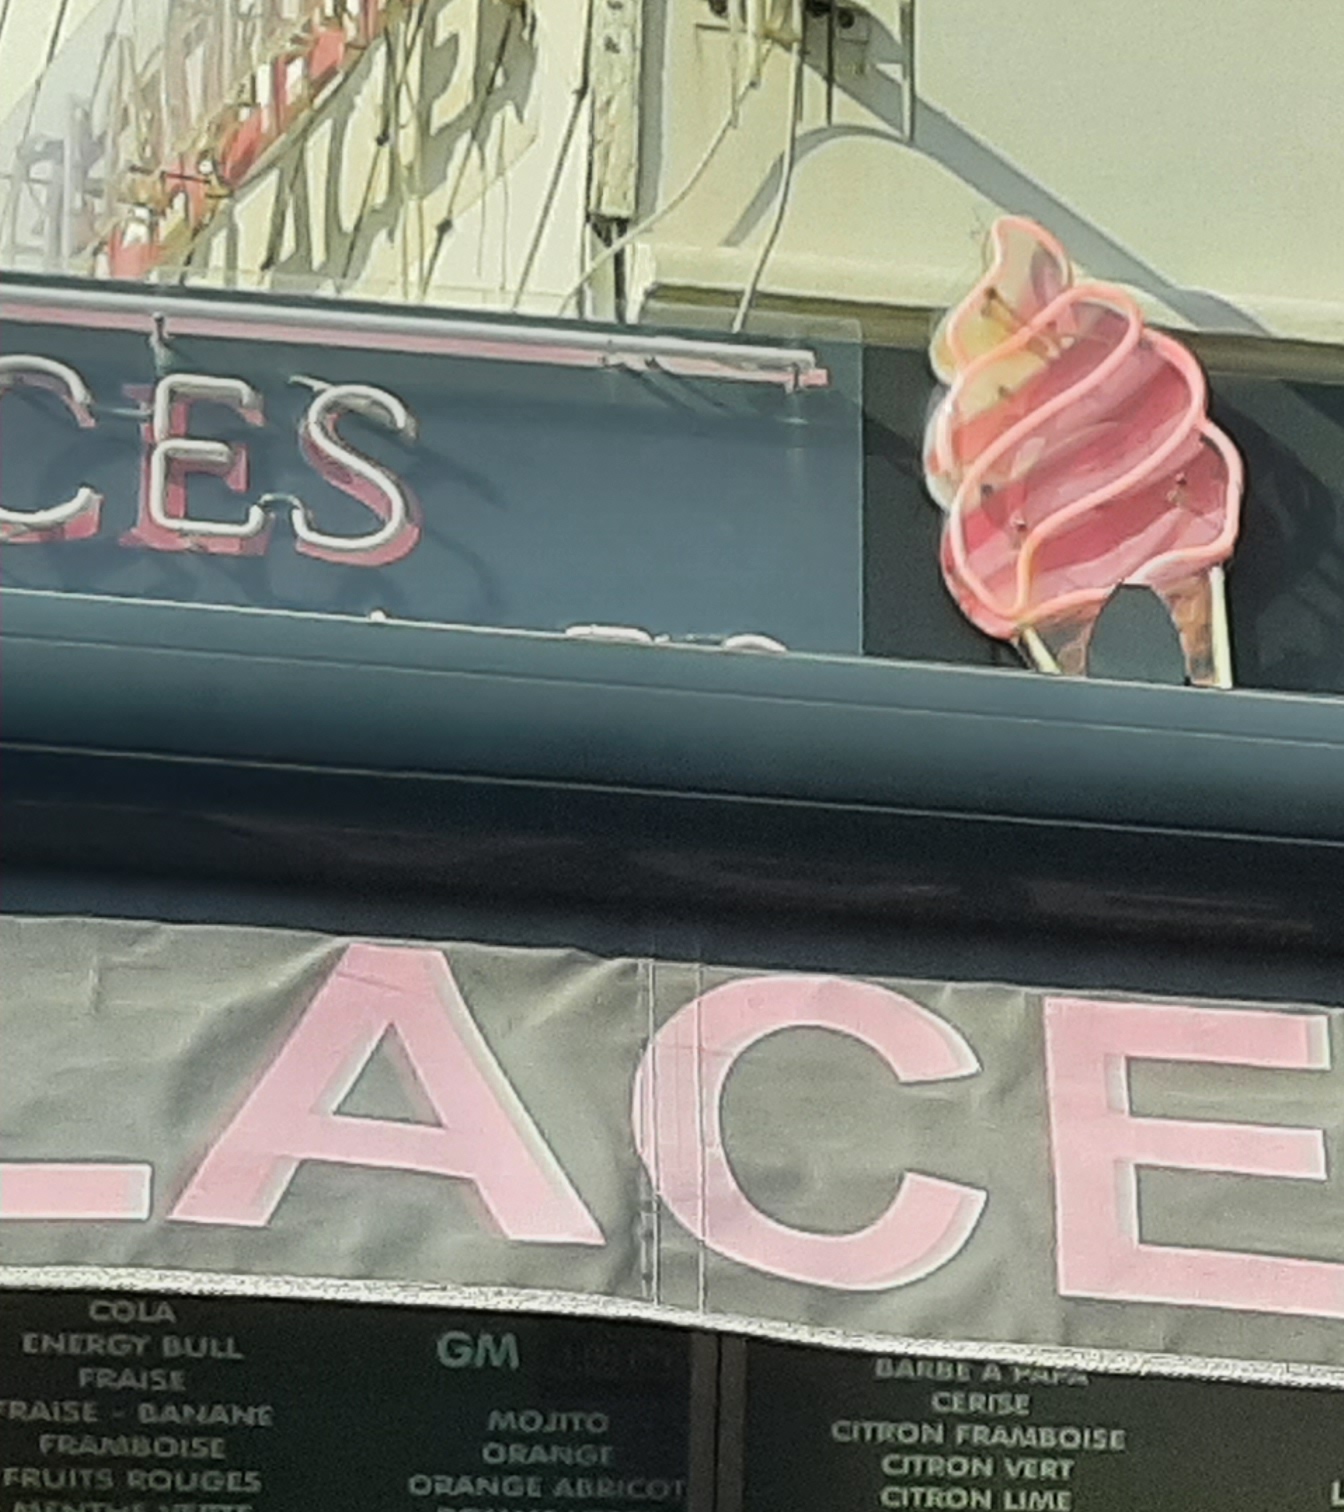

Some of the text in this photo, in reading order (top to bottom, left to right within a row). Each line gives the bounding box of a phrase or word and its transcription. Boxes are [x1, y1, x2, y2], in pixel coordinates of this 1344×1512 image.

[89, 1299, 177, 1325] COLA
[21, 1331, 246, 1360] ENERGY BULL
[436, 1328, 520, 1372] GM
[78, 1366, 188, 1392] FRAISE
[874, 1358, 971, 1382] BARBE
[137, 1402, 275, 1428] BANANE
[931, 1391, 1032, 1417] CERISE
[488, 1408, 610, 1435] MOJITO
[39, 1433, 227, 1460] FRAMBOISE
[830, 1419, 1128, 1452] CITRON FRAMBOISE
[481, 1440, 615, 1466] ORANGE
[3, 1467, 264, 1494] FRUITS ROUGES
[880, 1453, 1077, 1481] CITRON VERT
[408, 1472, 687, 1501] ORANGE ABRICOT
[880, 1486, 993, 1511] CITRON
